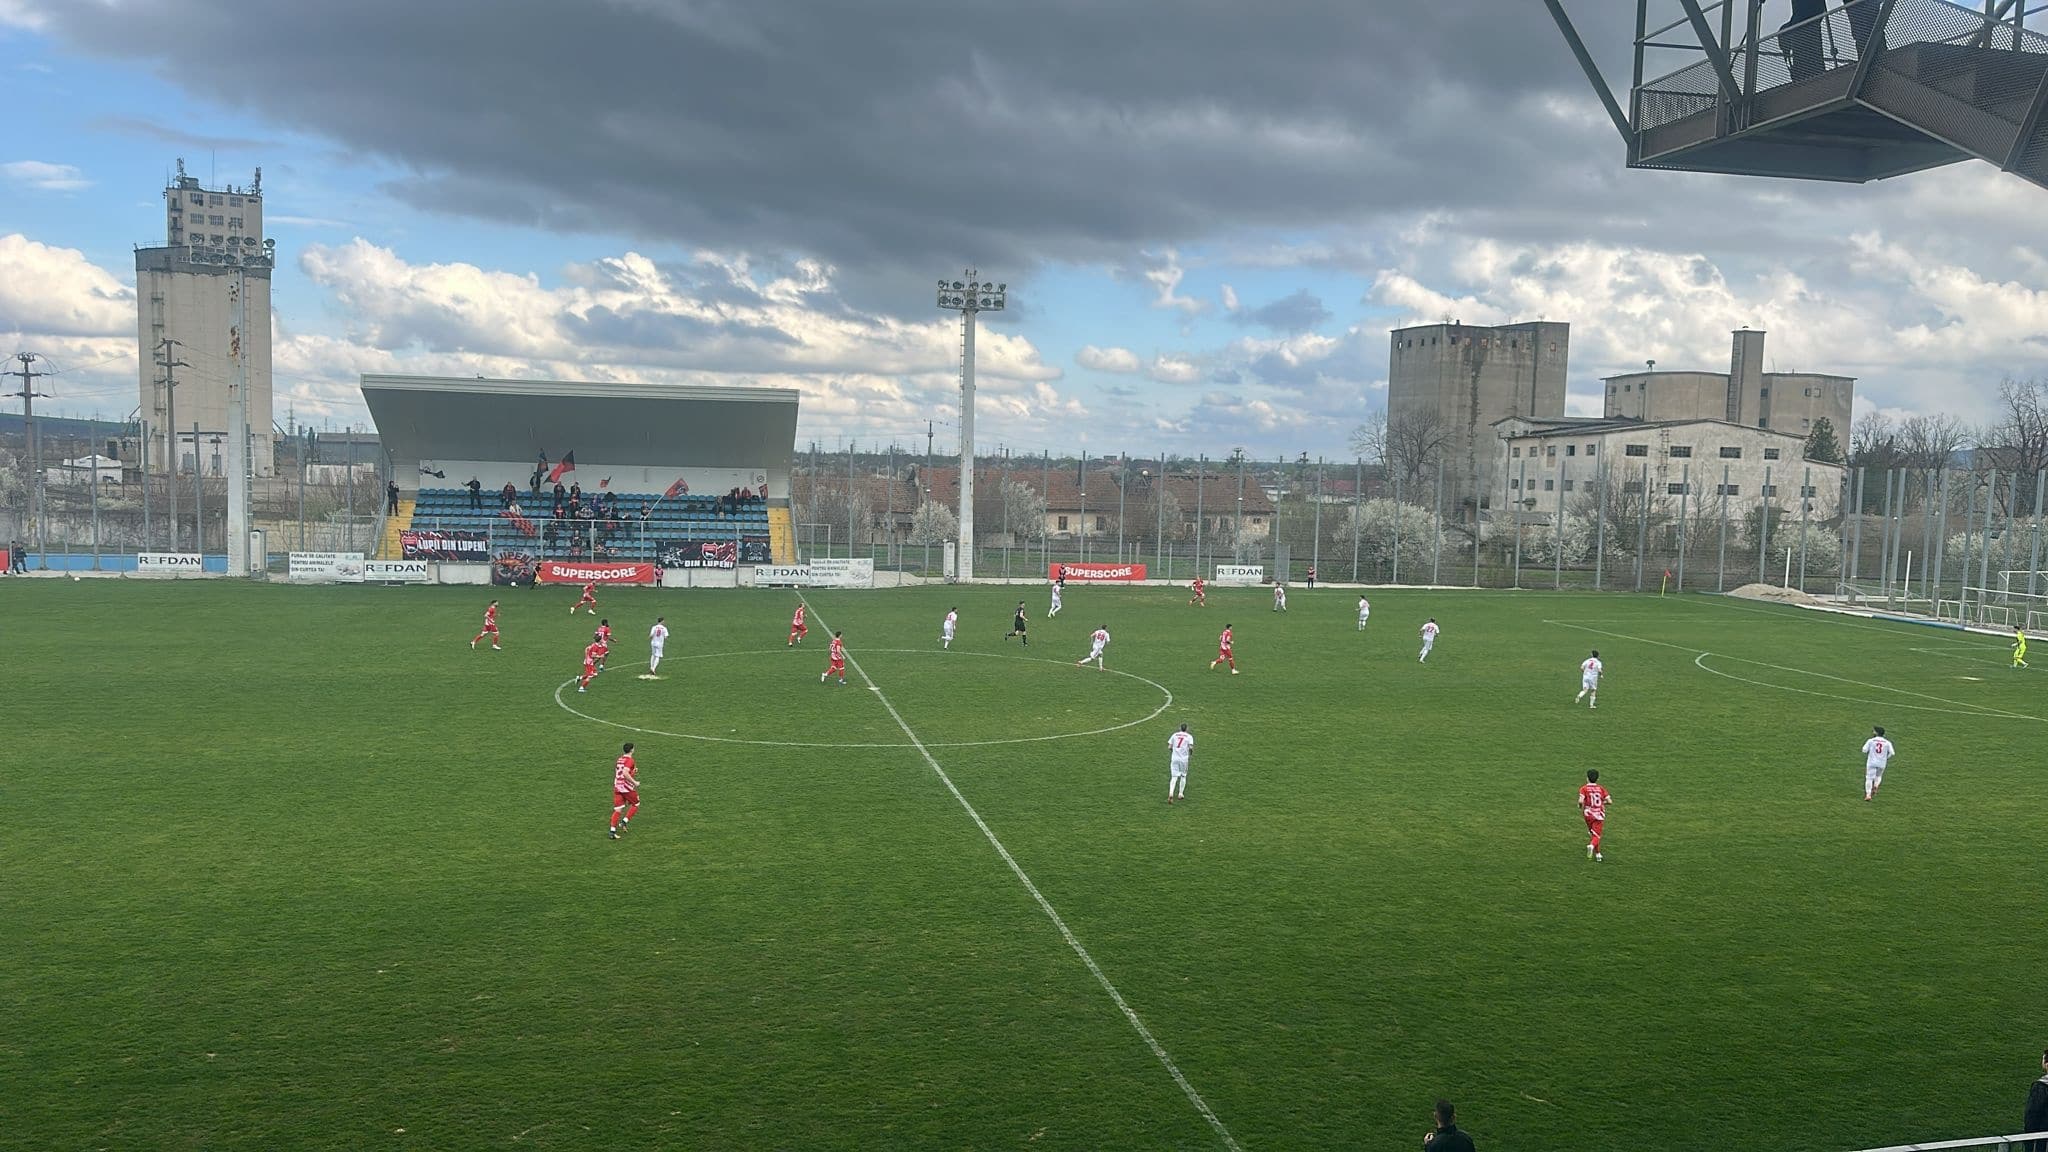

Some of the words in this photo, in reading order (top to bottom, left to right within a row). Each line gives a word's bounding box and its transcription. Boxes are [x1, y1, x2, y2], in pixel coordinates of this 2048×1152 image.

[417, 539, 441, 550] LUPII
[442, 540, 457, 551] DIN
[458, 540, 487, 551] LUPENI
[702, 560, 734, 568] LUPENI
[552, 565, 637, 580] SUPERSCORE
[1064, 566, 1132, 578] SUPERSCORE
[1176, 736, 1185, 749] 7
[1875, 742, 1883, 754] 3
[1589, 792, 1602, 807] 18
